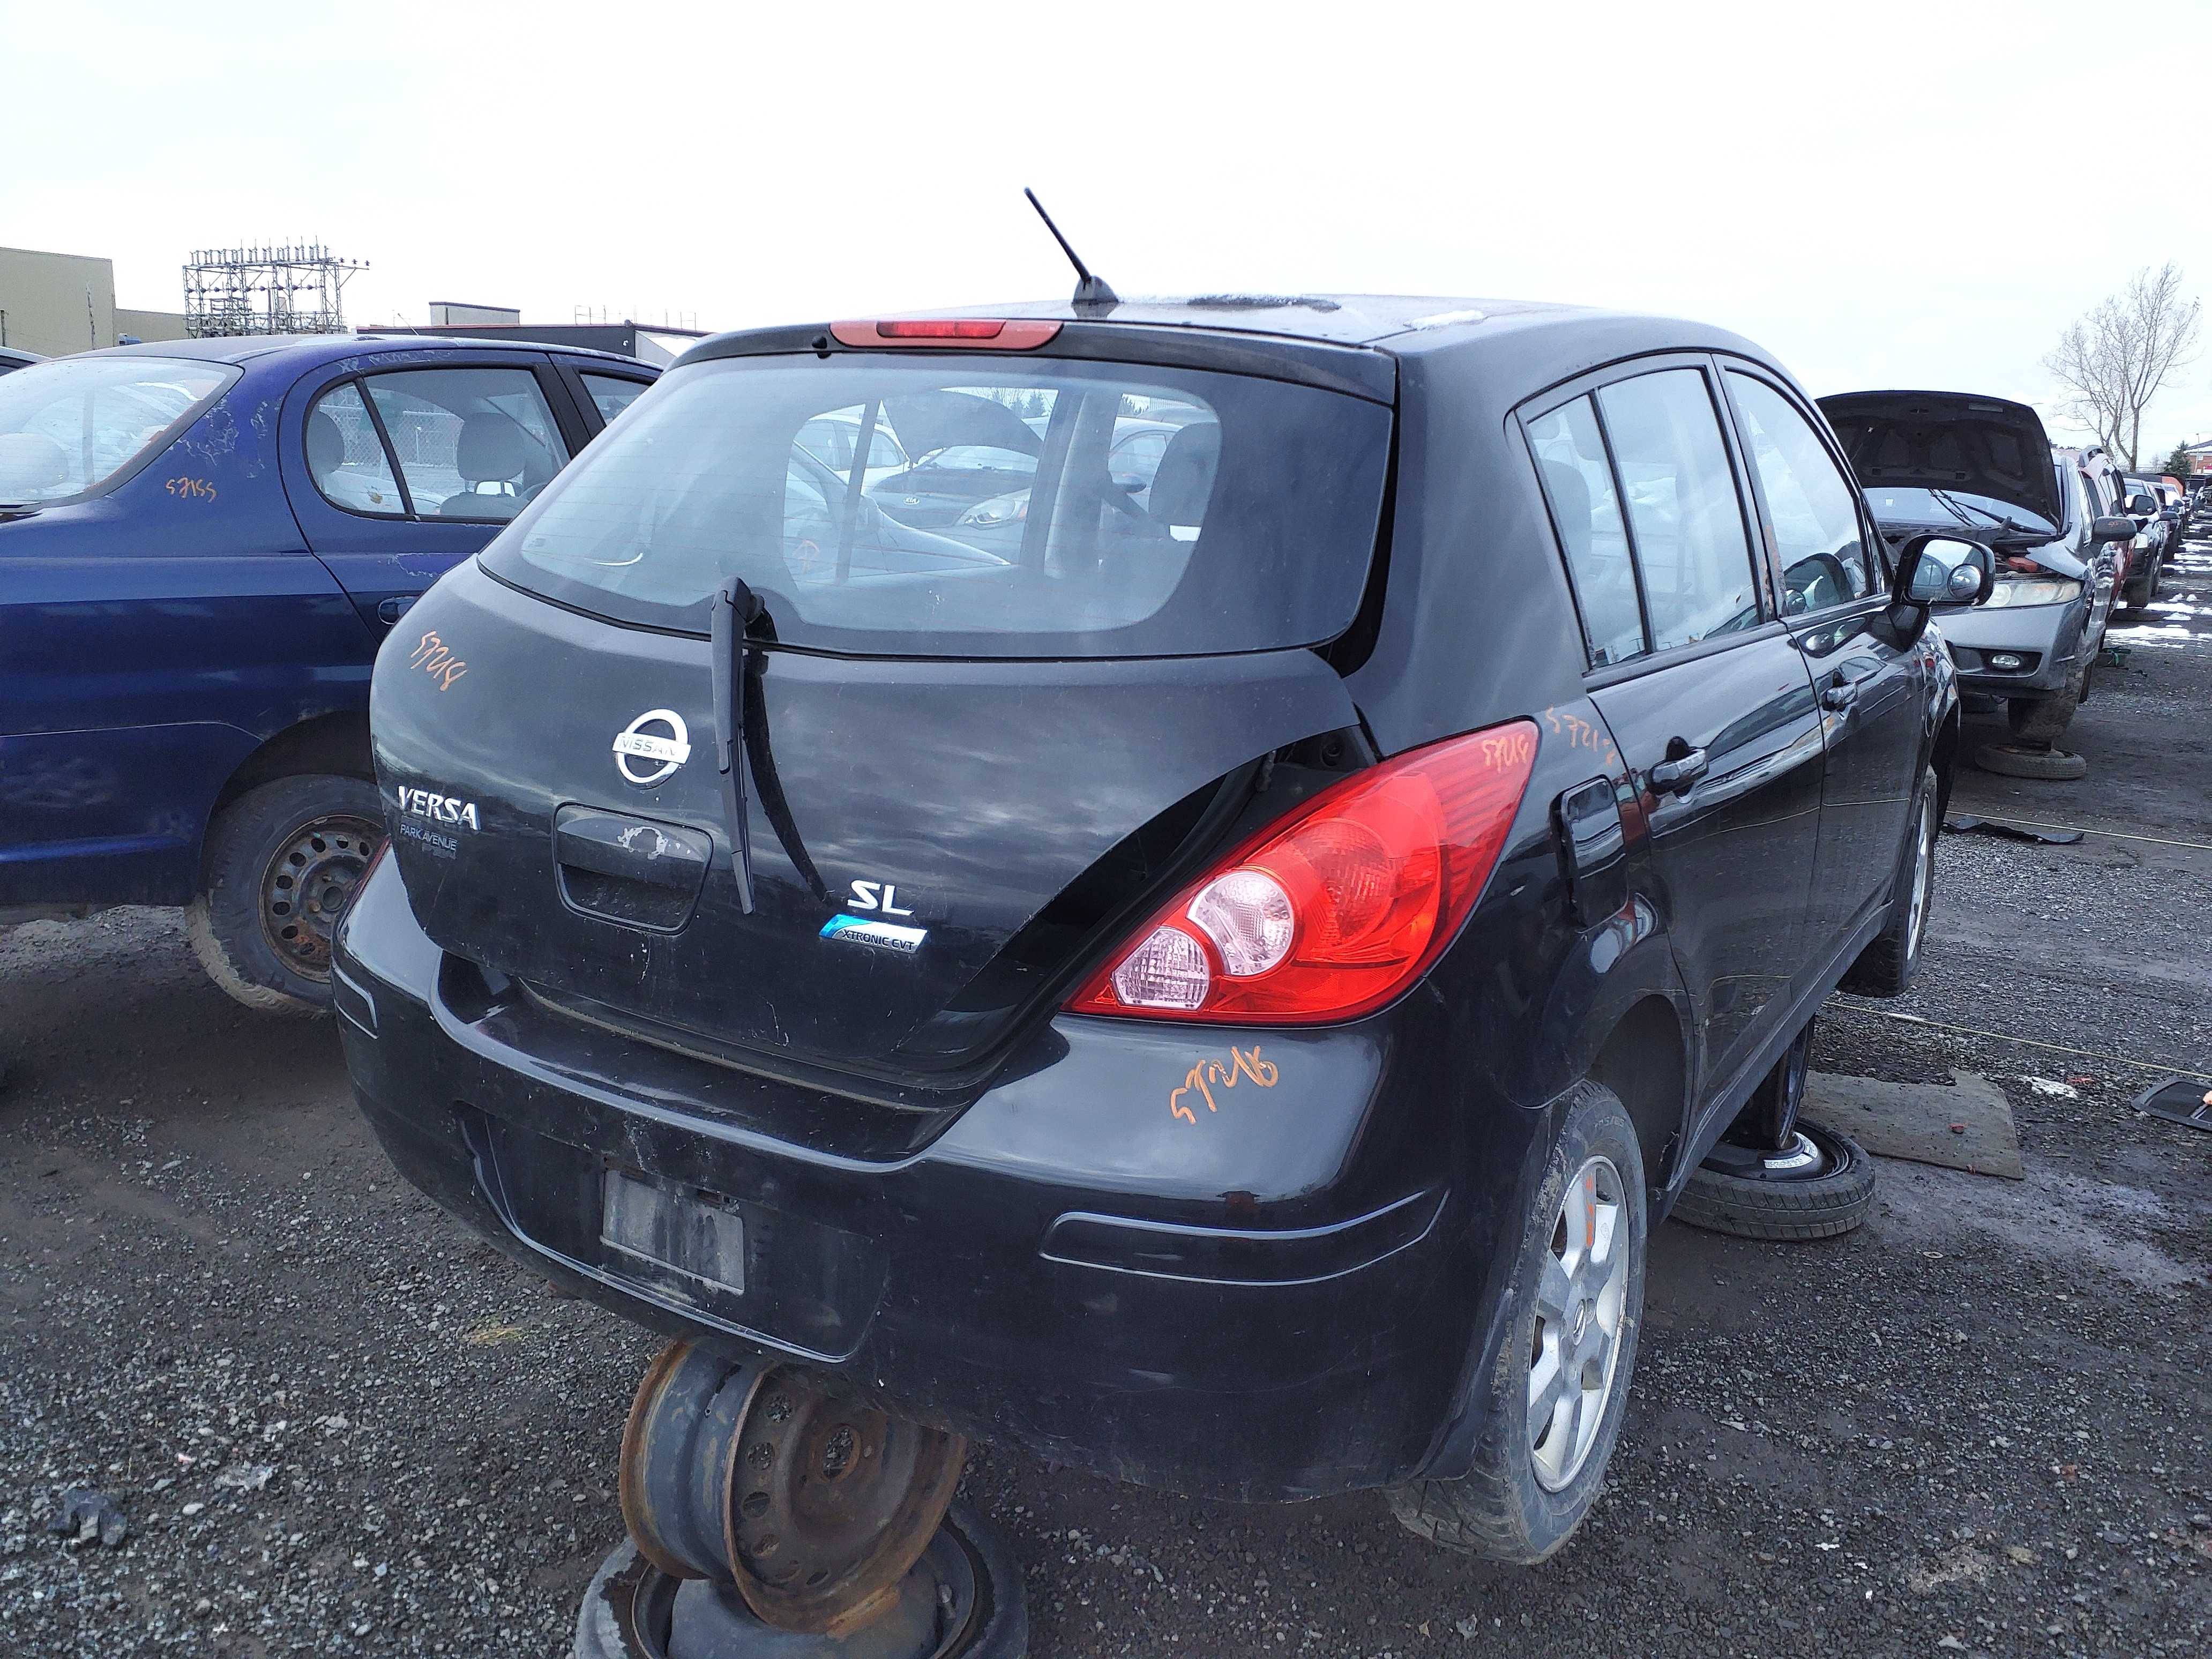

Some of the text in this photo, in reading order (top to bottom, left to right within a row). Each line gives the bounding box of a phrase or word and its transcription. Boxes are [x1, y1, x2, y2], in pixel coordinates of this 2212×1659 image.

[618, 736, 677, 756] NISSAN
[398, 786, 481, 831] VERSA
[400, 824, 458, 851] PARK AVENUE
[847, 879, 914, 916] SL
[843, 929, 915, 951] XTRONIC CVT
